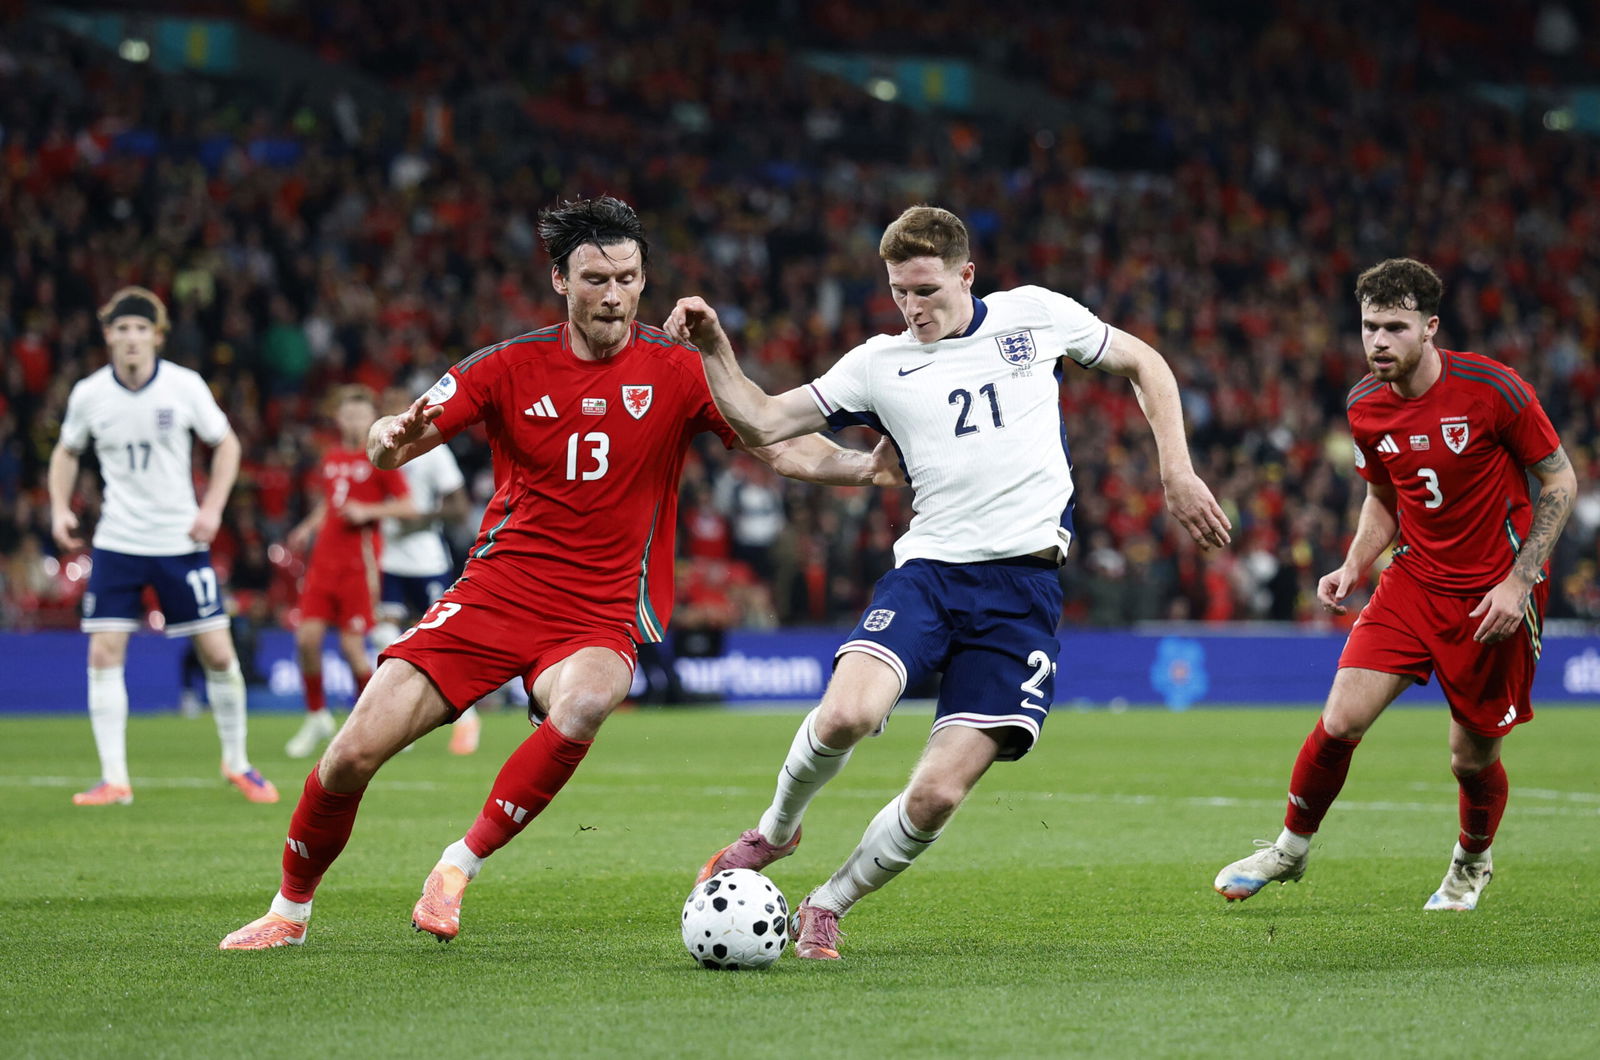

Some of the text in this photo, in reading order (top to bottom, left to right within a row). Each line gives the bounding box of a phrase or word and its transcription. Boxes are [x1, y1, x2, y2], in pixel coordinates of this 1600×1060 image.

[948, 382, 1005, 438] 21
[126, 442, 152, 472] 17
[566, 431, 610, 481] 13
[1417, 467, 1443, 509] 3
[186, 566, 218, 606] 17
[1020, 650, 1057, 699] 2
